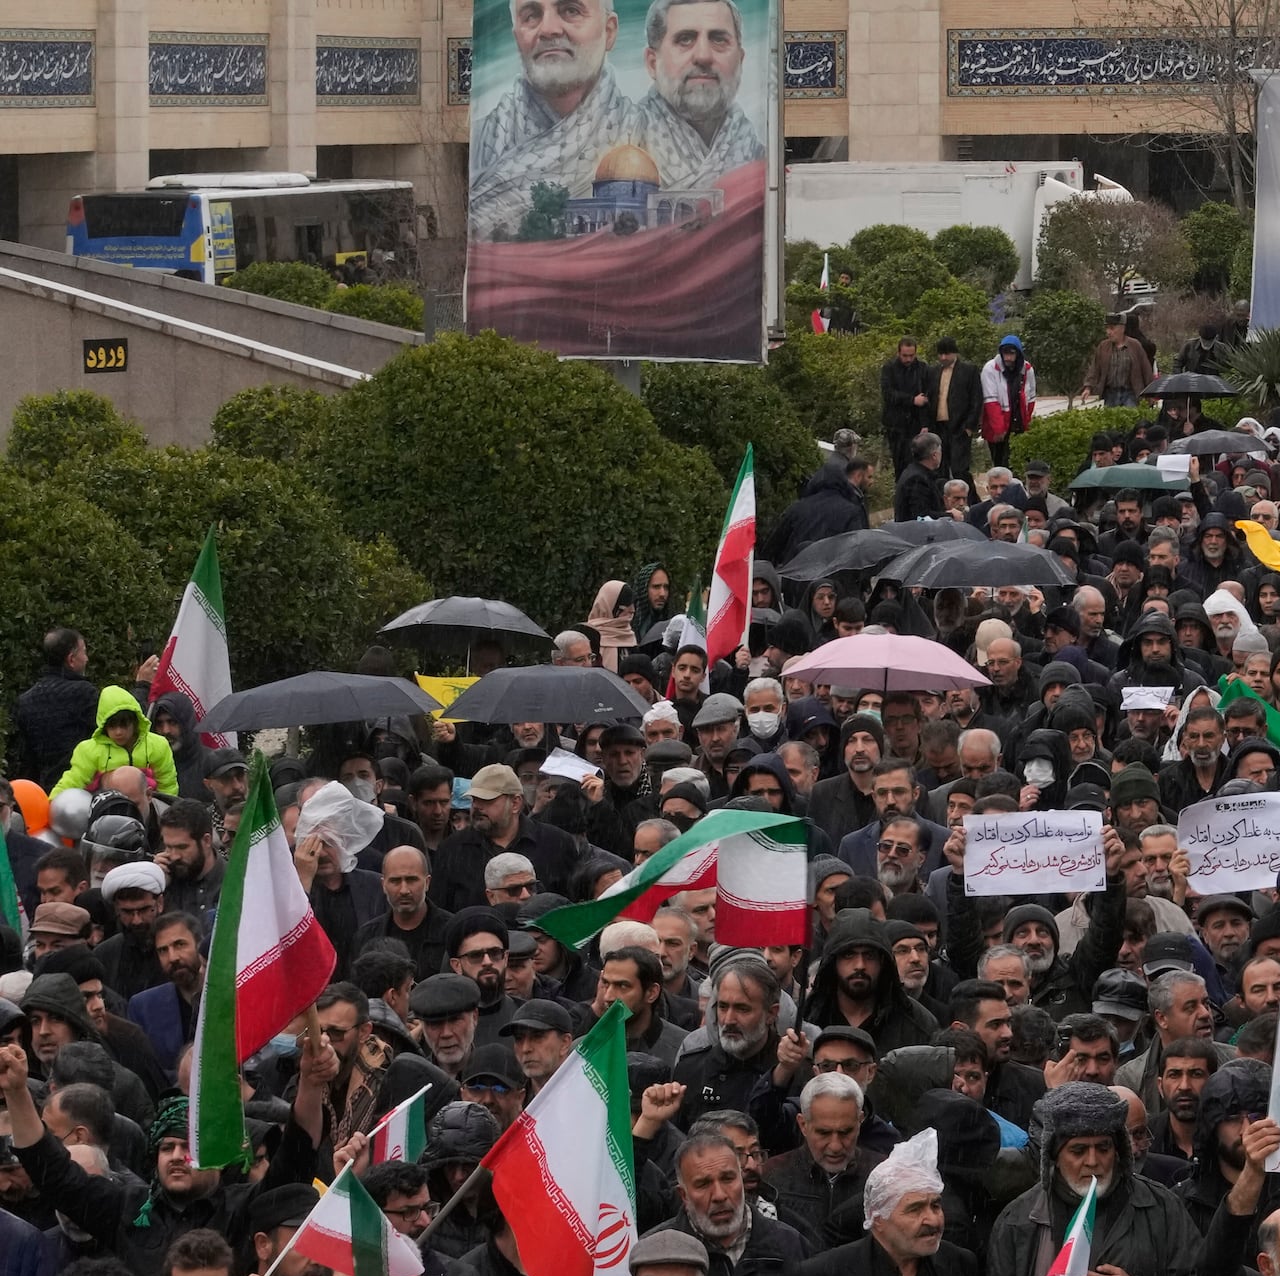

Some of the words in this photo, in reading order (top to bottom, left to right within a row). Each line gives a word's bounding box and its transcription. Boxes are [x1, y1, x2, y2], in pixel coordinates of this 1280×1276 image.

[86, 346, 125, 369] ورود
[975, 821, 1000, 842] افتاد
[1055, 829, 1063, 841] به
[1064, 817, 1092, 843] ترامپ
[1188, 824, 1211, 845] افتاد
[1263, 827, 1272, 840] به
[1059, 854, 1089, 877] شروع
